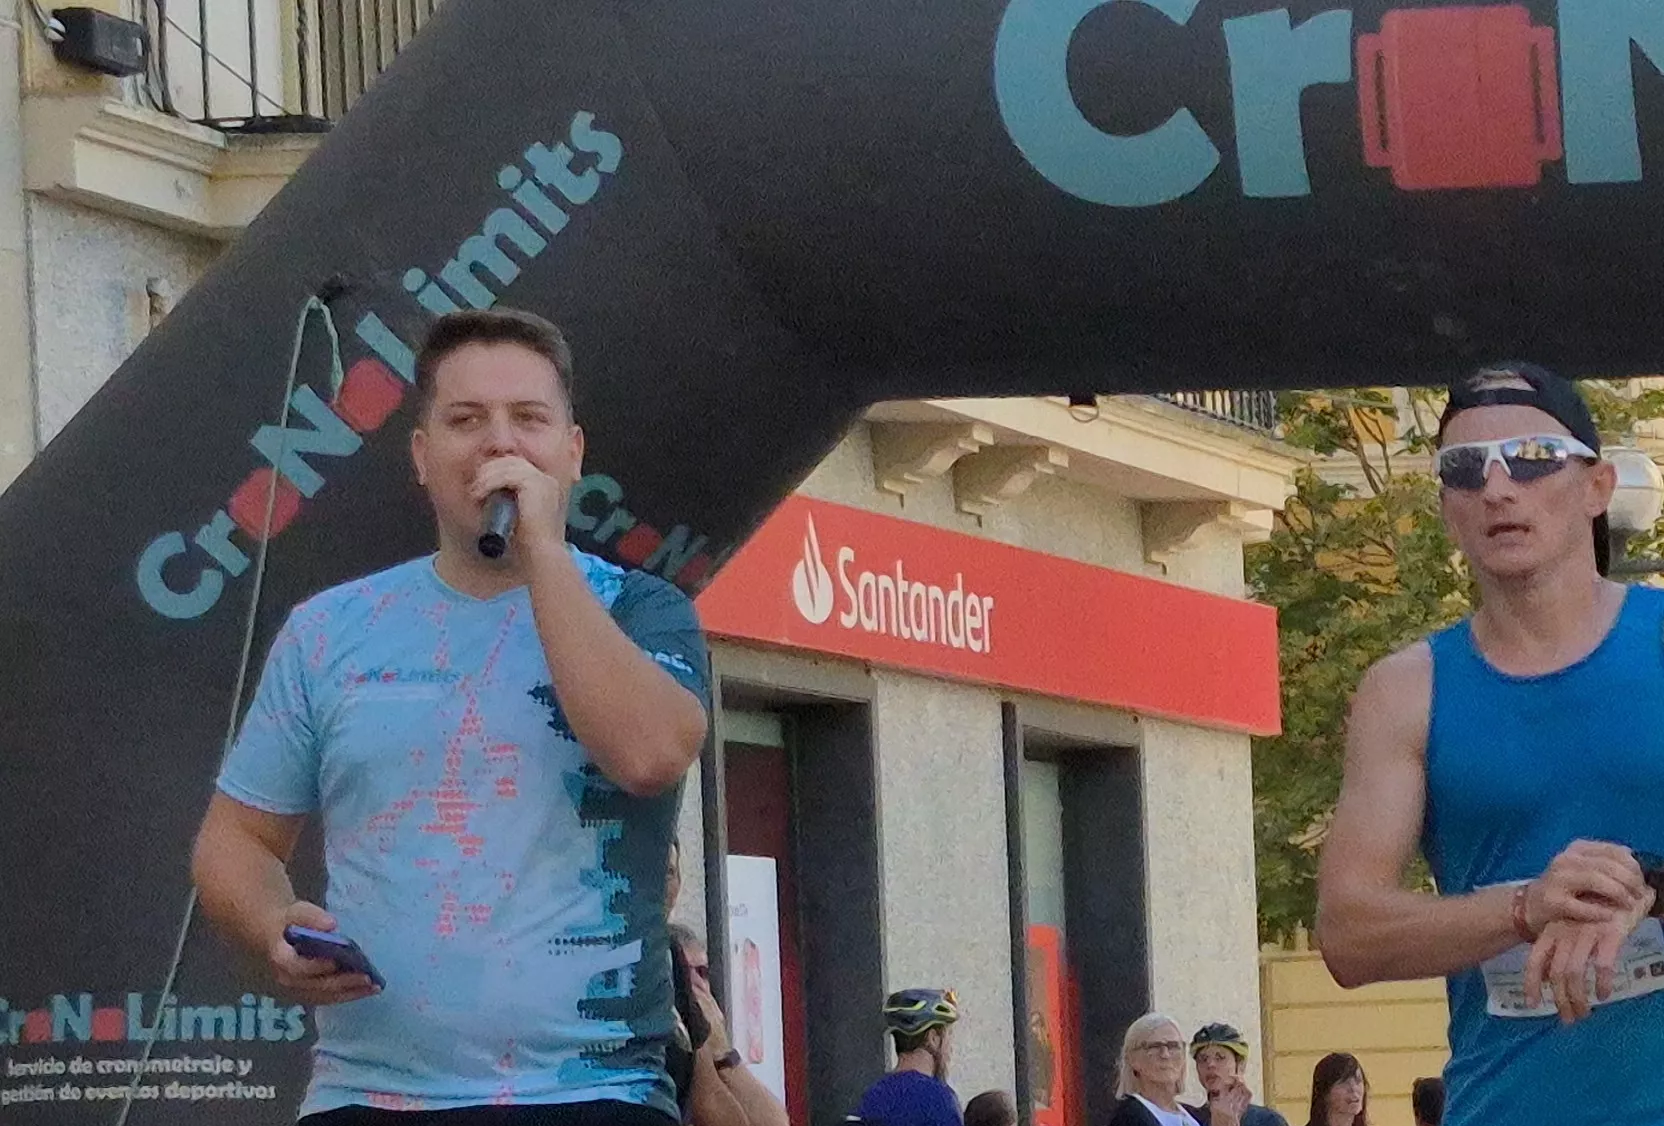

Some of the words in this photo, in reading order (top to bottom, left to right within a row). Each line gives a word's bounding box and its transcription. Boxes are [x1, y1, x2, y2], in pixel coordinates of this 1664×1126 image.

[838, 546, 994, 653] Santander
[69, 1056, 93, 1074] de
[236, 1058, 252, 1076] y
[164, 1081, 276, 1101] deportivos
